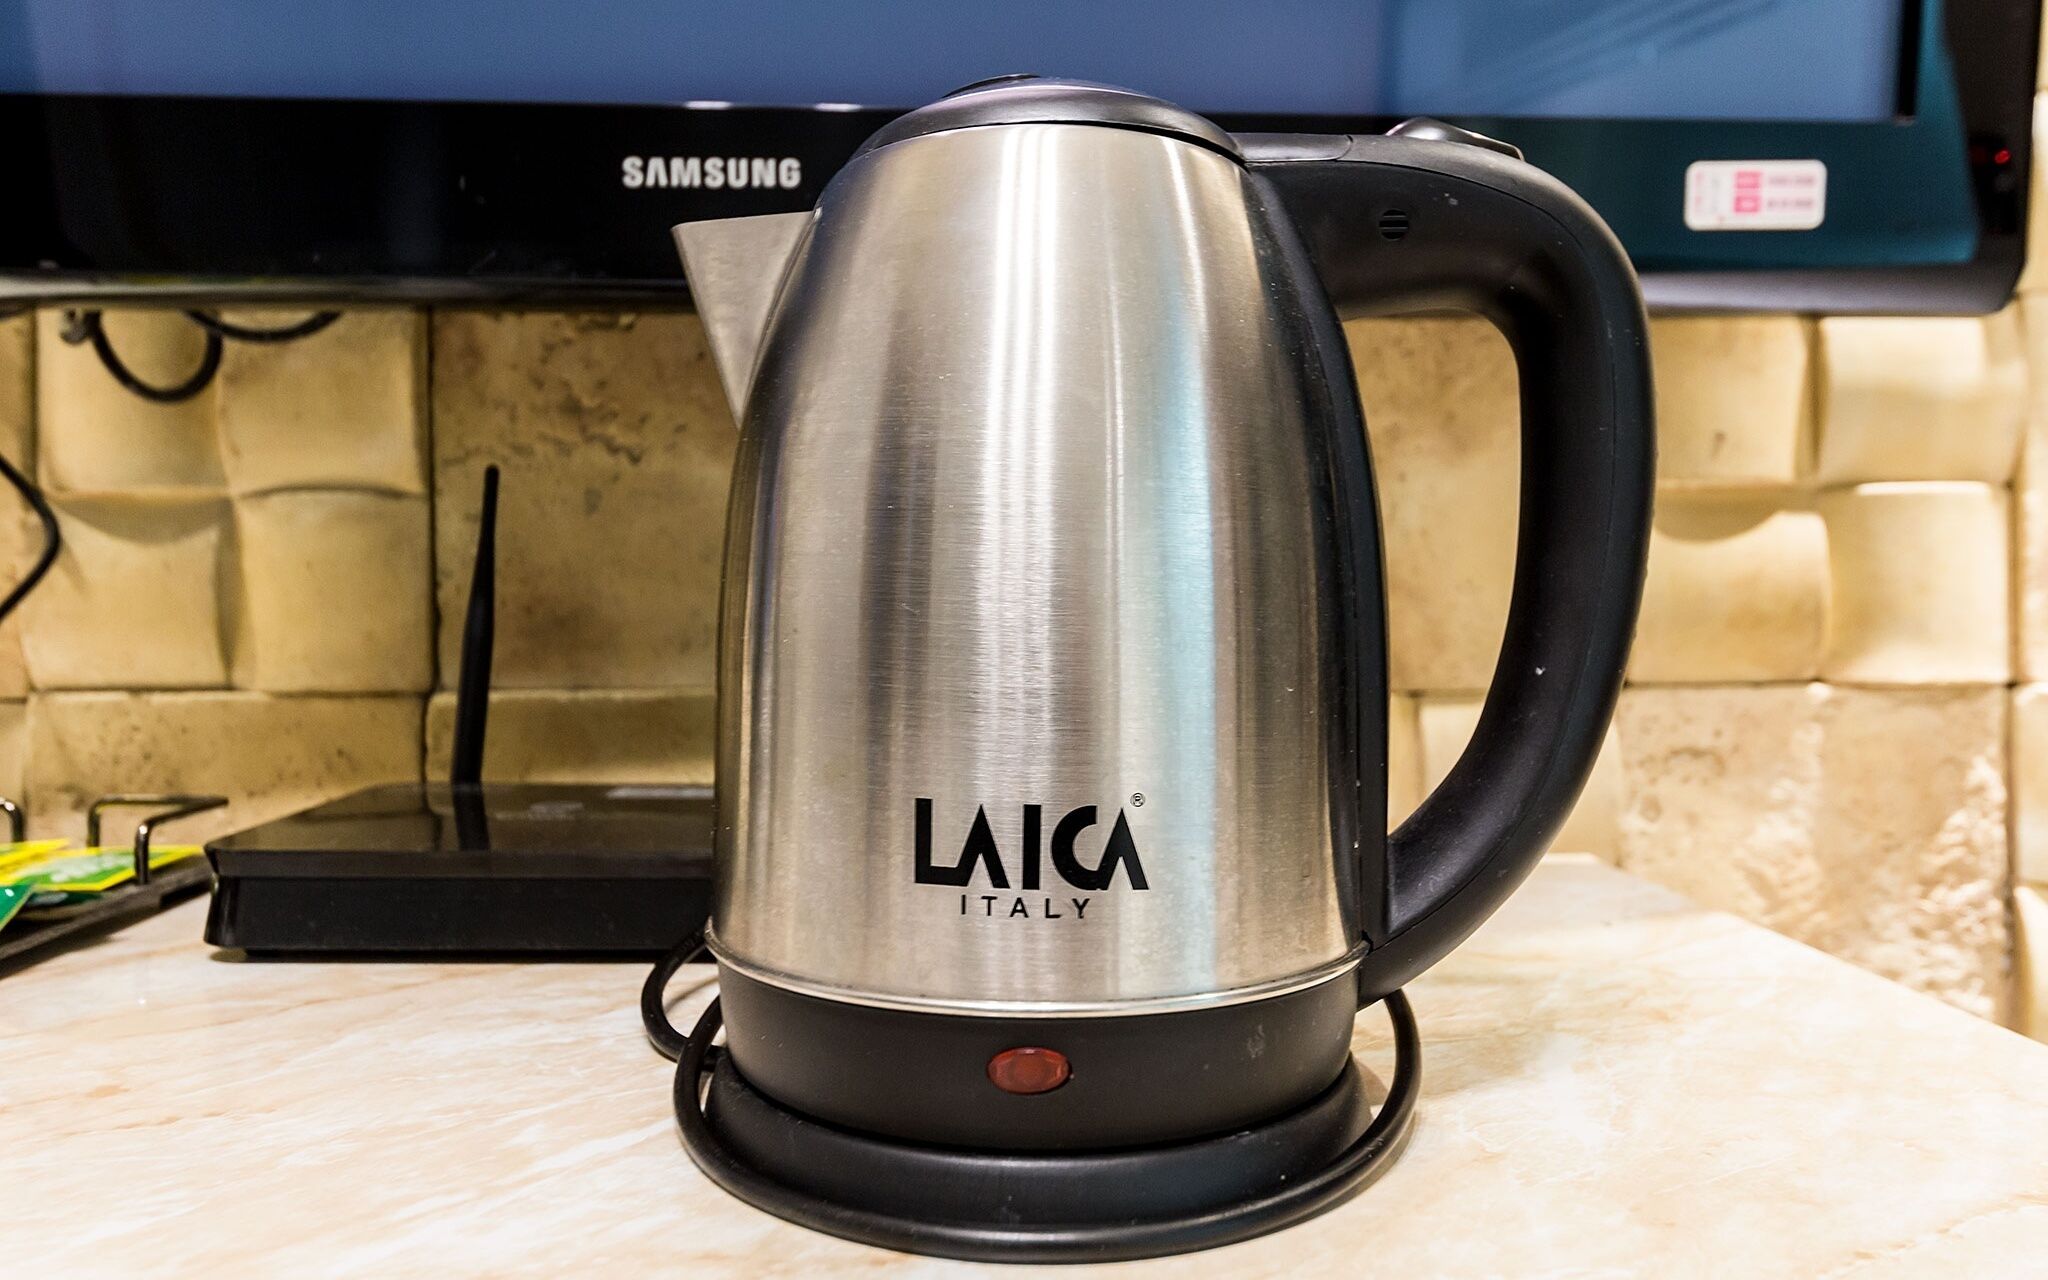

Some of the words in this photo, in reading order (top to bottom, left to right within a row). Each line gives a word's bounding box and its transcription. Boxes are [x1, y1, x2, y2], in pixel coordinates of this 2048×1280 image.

[622, 155, 801, 189] SAMSUNG
[914, 797, 1150, 891] LAICA
[961, 894, 1090, 919] ITALY
